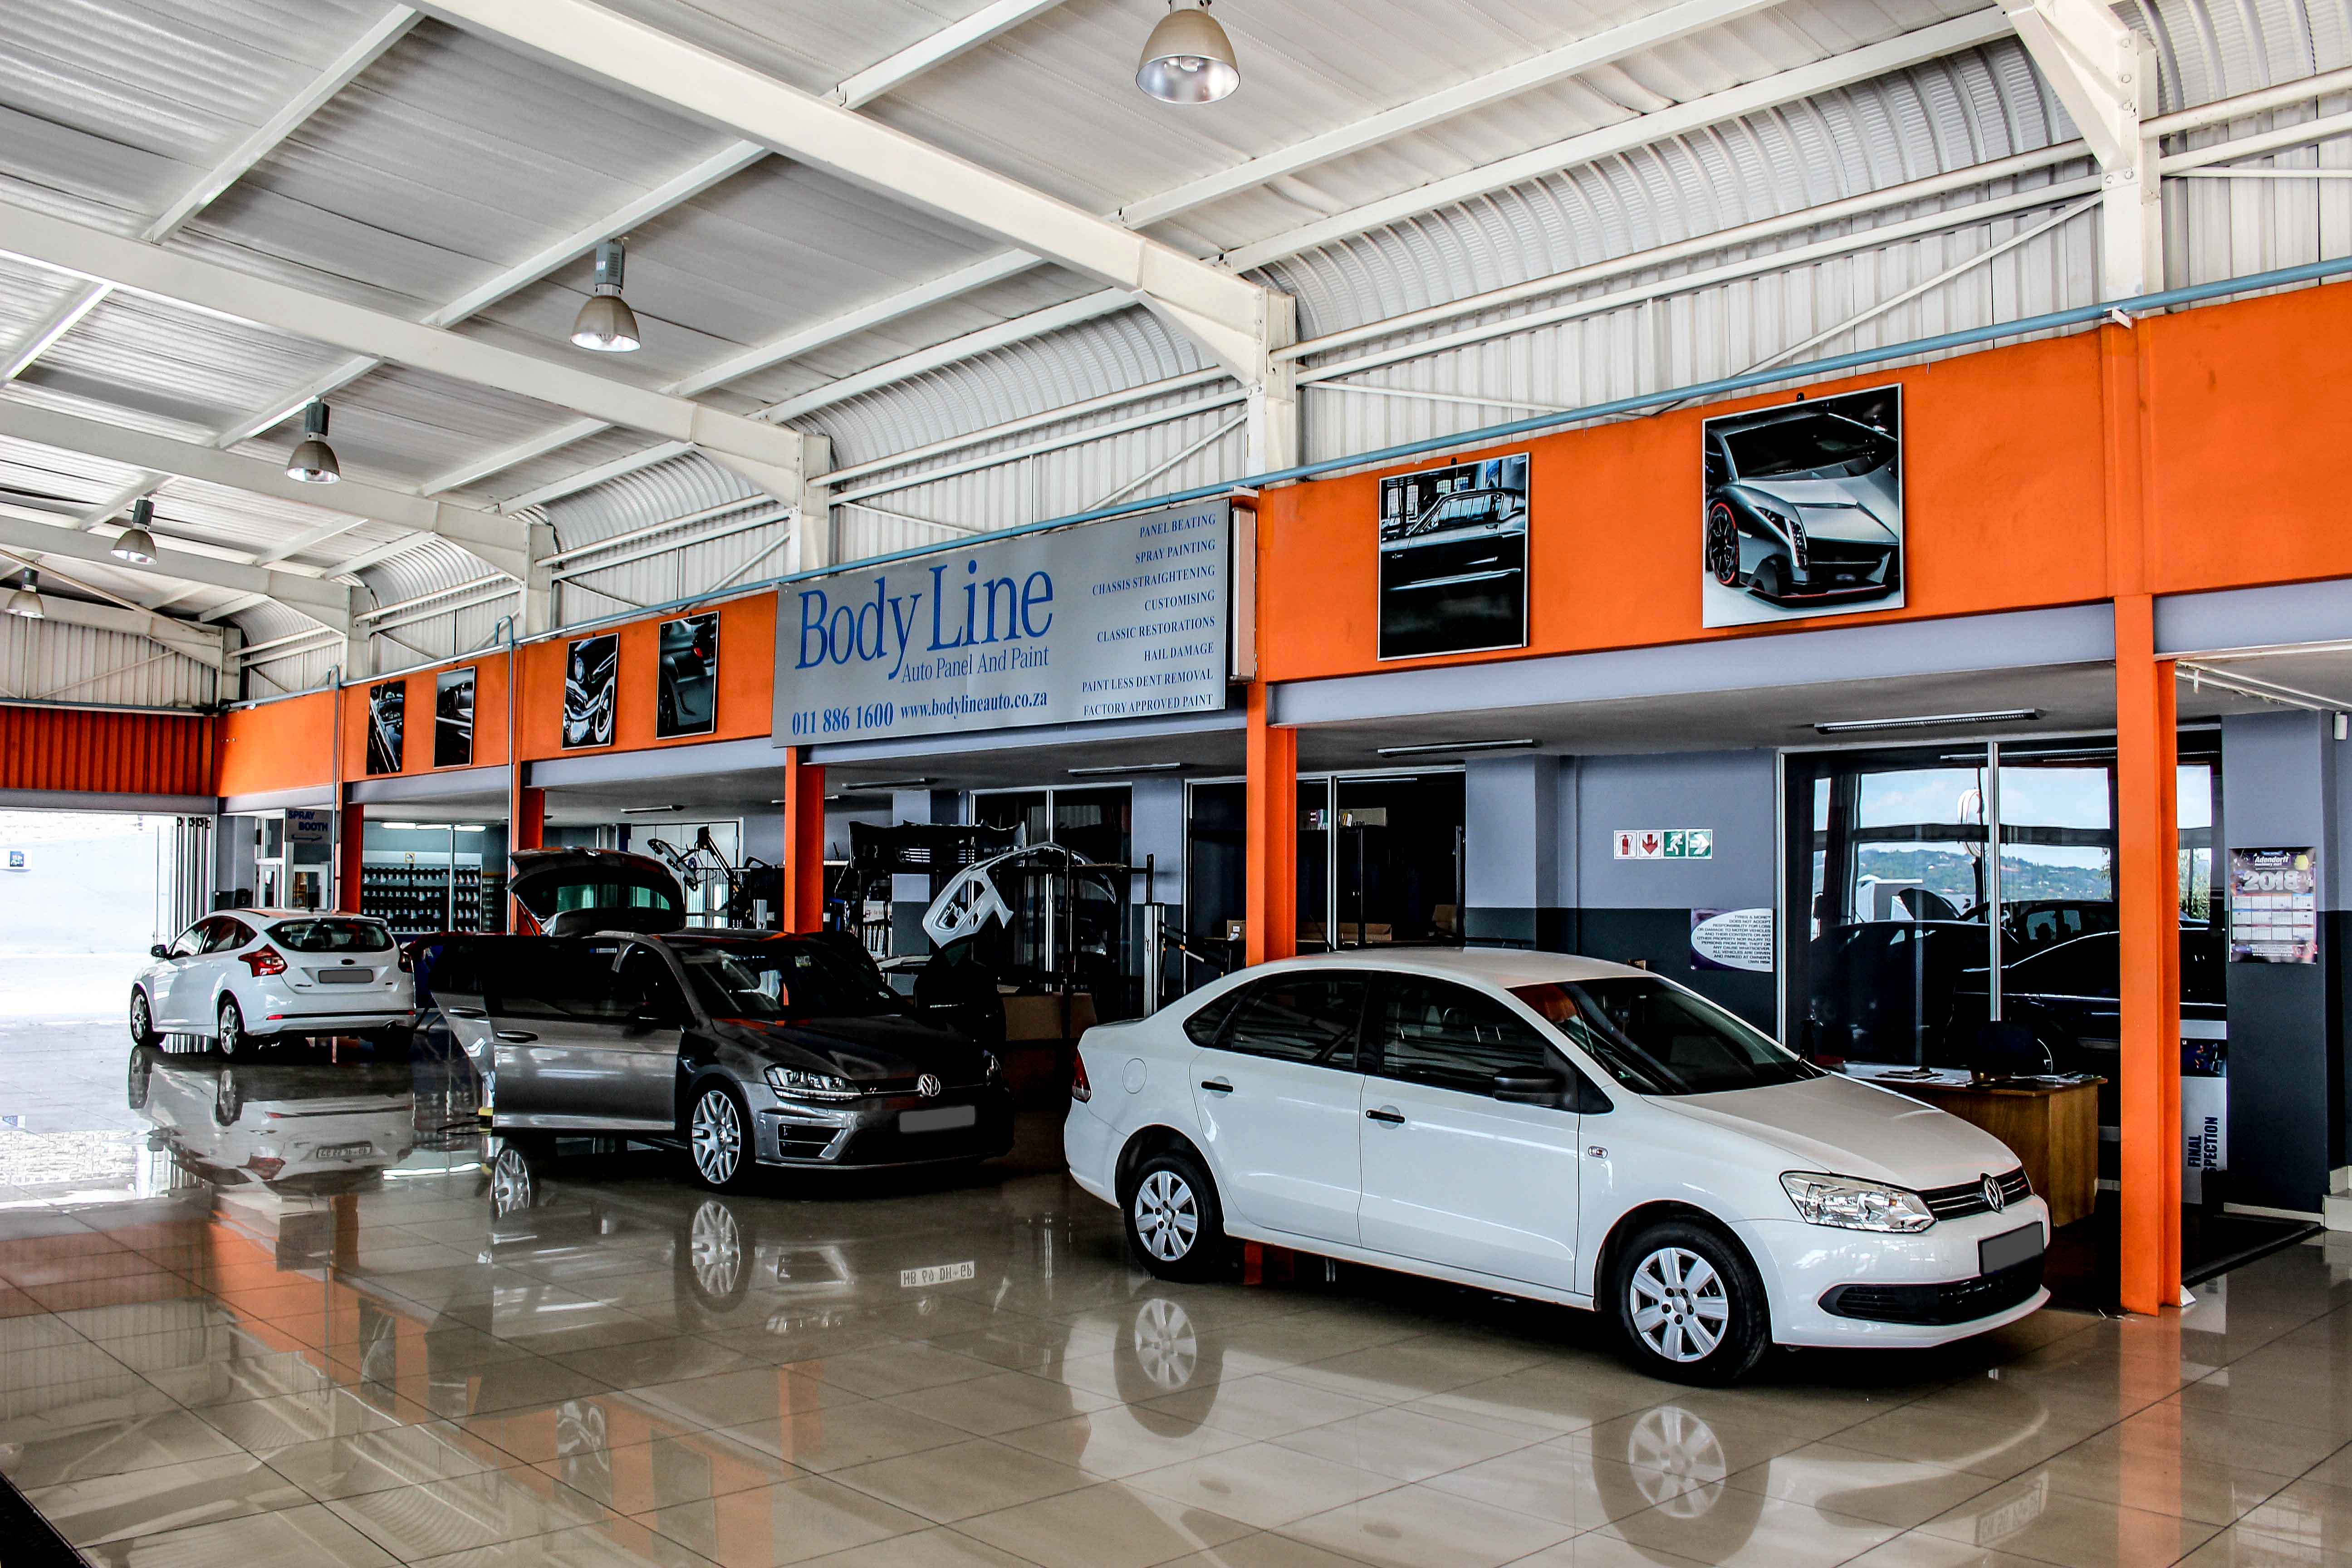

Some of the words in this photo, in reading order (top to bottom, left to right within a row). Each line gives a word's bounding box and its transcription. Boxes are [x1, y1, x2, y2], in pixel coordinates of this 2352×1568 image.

[1140, 522, 1169, 538] PANEL
[1171, 514, 1216, 532] BEATING
[1135, 548, 1165, 564] SPRAY
[1167, 539, 1215, 558] PAINTING
[1092, 579, 1131, 596] CHASSIS
[1132, 565, 1215, 588] STRAIGHTENING
[1144, 589, 1215, 611] CUSTOMISING
[795, 576, 922, 680] Body
[927, 559, 1053, 651] Line
[1097, 627, 1136, 643] CLASSIC
[1139, 616, 1215, 637] RESTORATIONS
[901, 661, 932, 683] Auto
[936, 653, 973, 679] Panel
[977, 649, 1007, 674] And
[1011, 645, 1049, 669] Paint
[1144, 649, 1168, 661] HAIL
[1170, 642, 1214, 658] DAMAGE
[1082, 679, 1109, 693] PAINT
[1111, 676, 1133, 690] LESS
[1136, 674, 1161, 688] DENT
[1164, 668, 1213, 685] REMOVAL
[901, 691, 1048, 719] www.bodylineauto.co.za
[1084, 702, 1127, 716] FACTORY
[1129, 697, 1180, 712] APPROVED
[1182, 693, 1213, 707] PAINT
[792, 711, 816, 735] 011
[823, 707, 850, 732] 886
[856, 701, 894, 729] 1600
[288, 810, 315, 819] SPRAY
[299, 822, 328, 831] BOOTH
[2243, 870, 2299, 891] 2018
[2187, 1135, 2201, 1167] FINAL
